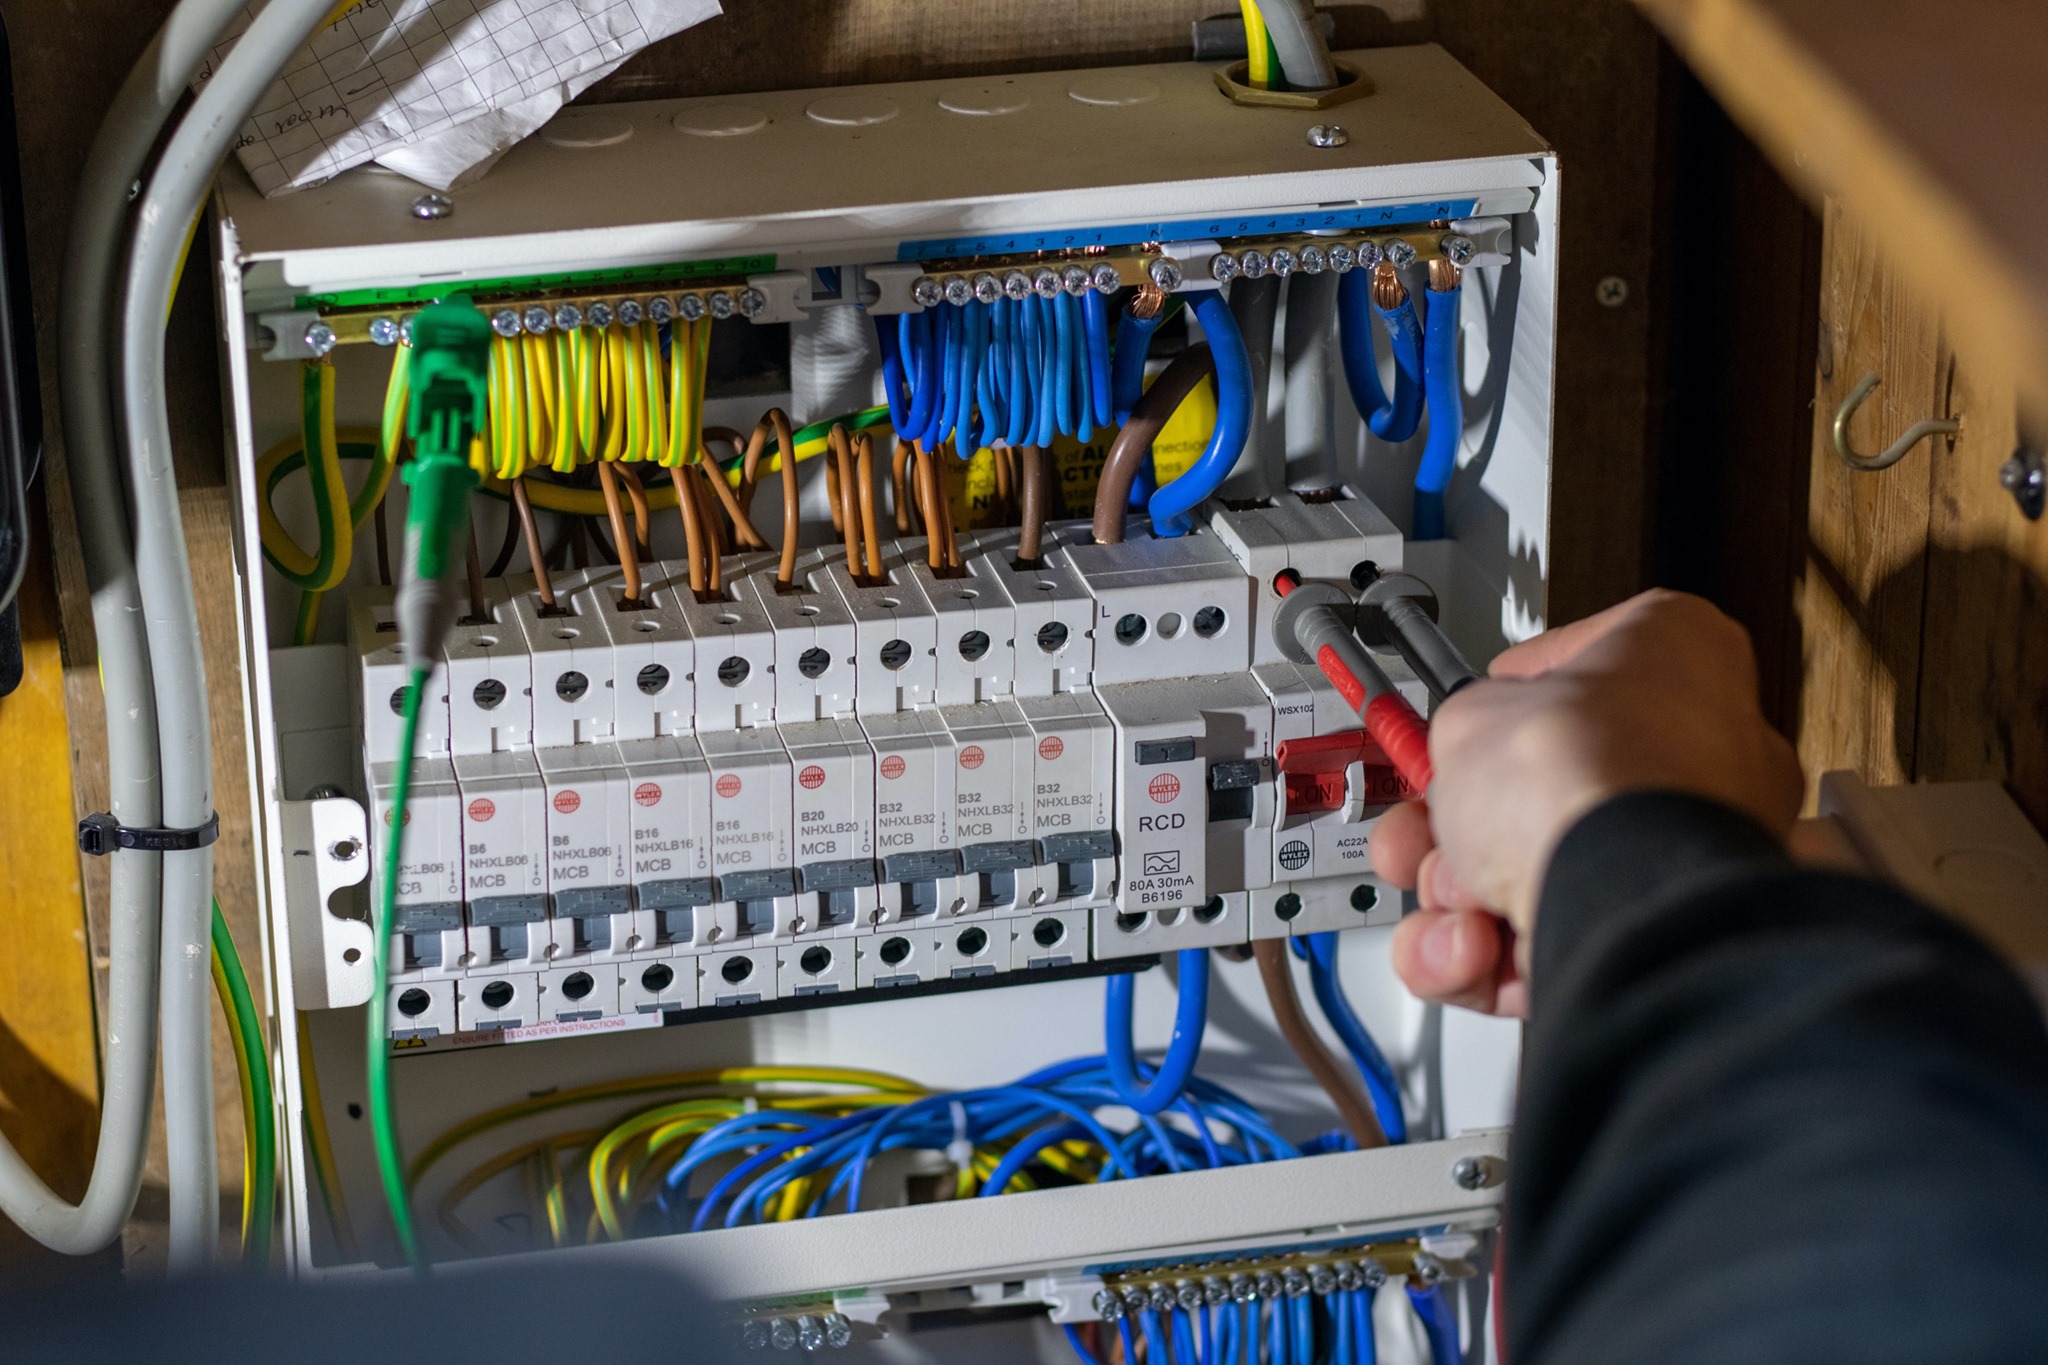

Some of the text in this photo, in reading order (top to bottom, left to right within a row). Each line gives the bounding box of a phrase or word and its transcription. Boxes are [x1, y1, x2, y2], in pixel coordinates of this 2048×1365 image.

[275, 104, 349, 134] room
[1209, 206, 1450, 233] 6 5 4 3 2 1 N N
[976, 242, 987, 251] 5
[1006, 240, 1015, 248] 4
[1035, 238, 1045, 247] 3
[1064, 235, 1075, 244] 2
[1096, 233, 1102, 242] 1
[1151, 229, 1163, 237] N
[1101, 605, 1111, 618] L
[1277, 704, 1315, 716] WSX102
[1037, 783, 1061, 795] B32
[1150, 785, 1179, 794] WYLEX
[1304, 783, 1333, 802] ON
[1381, 776, 1409, 796] ON
[958, 792, 982, 804] B32
[1037, 794, 1093, 809] NHXLB32
[879, 802, 903, 814] B32
[957, 804, 1014, 818] NHXLB32
[801, 810, 825, 822] B20
[879, 814, 936, 828] NHXLB32
[1037, 813, 1072, 828] MCB
[1139, 813, 1185, 832] RCD
[716, 820, 740, 832] B16
[801, 822, 859, 836] NHXLB20
[958, 823, 993, 837] MCB
[553, 835, 570, 846] B6
[634, 828, 659, 840] B16
[716, 831, 774, 845] NHXLB16
[879, 832, 914, 847] MCB
[469, 844, 486, 855] B6
[635, 839, 694, 853] NHXLB16
[801, 841, 836, 855] MCB
[1336, 837, 1369, 848] AC22A
[553, 846, 612, 860] NHXLB06
[716, 850, 752, 865] MCB
[1280, 850, 1309, 860] WYLEX
[1341, 850, 1365, 859] 100A
[469, 855, 529, 869] NHXLB06
[635, 858, 671, 873] MCB
[553, 865, 589, 880] MCB
[470, 874, 506, 889] MCB
[1129, 875, 1194, 892] 80A 30mA
[1141, 889, 1183, 904] B6196
[452, 1033, 490, 1046] ENSURE
[491, 1028, 523, 1043] FITTED
[525, 1028, 538, 1037] AS
[539, 1026, 558, 1036] PER
[559, 1018, 626, 1034] INSTRUCTIONS
